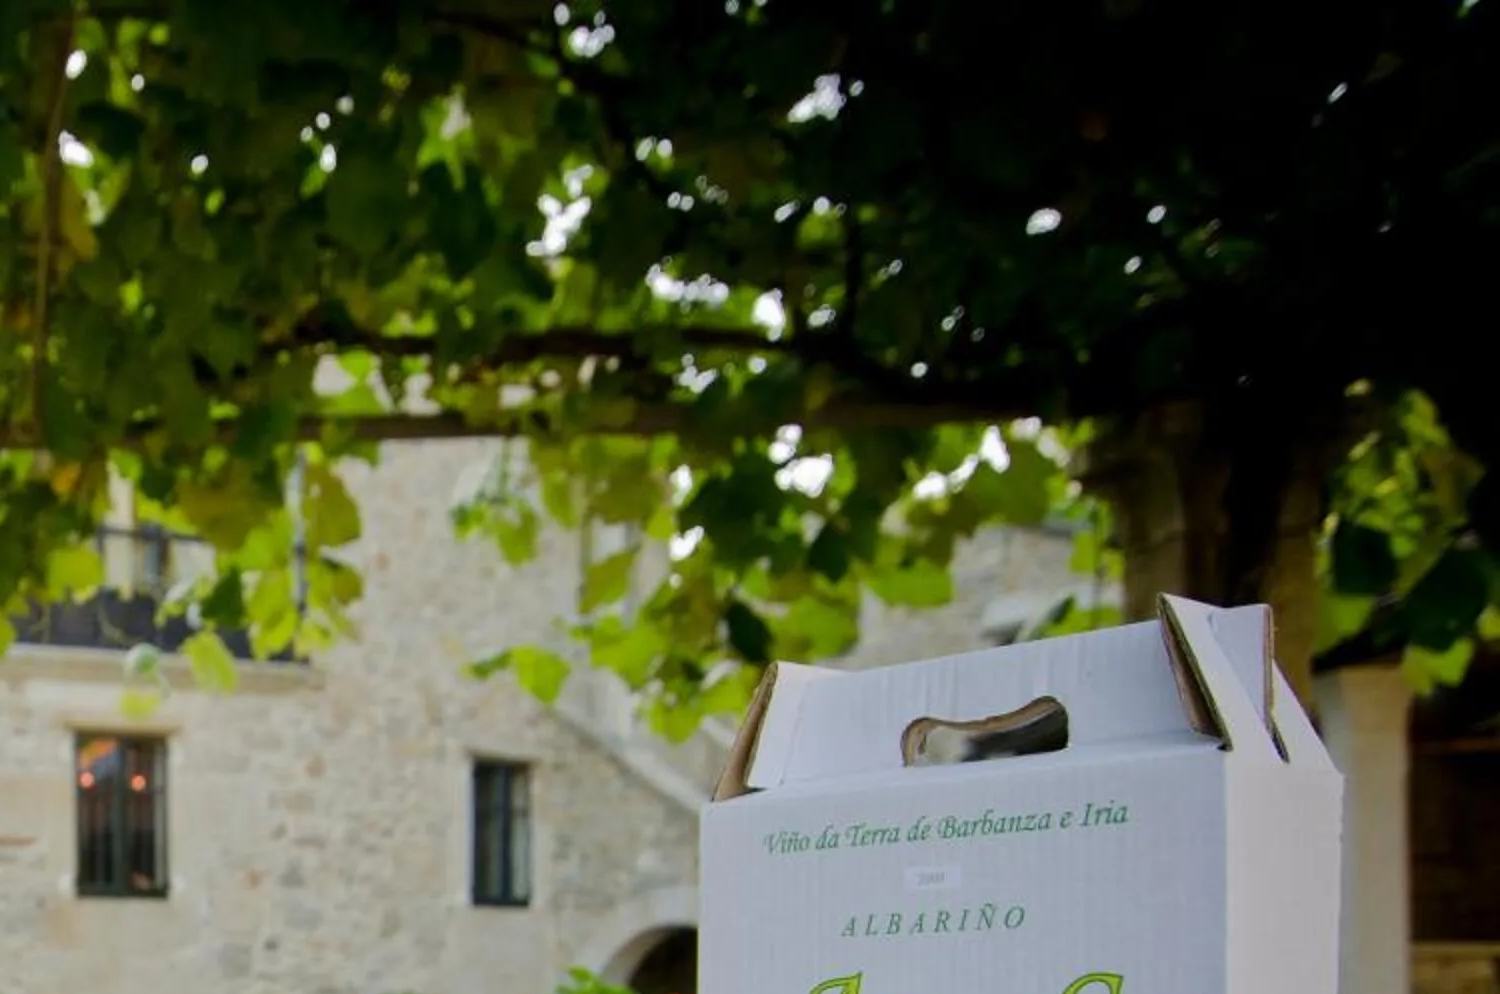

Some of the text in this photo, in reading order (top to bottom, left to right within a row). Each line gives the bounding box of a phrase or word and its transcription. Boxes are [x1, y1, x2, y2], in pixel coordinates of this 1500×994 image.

[764, 800, 1129, 854] Viño da Terra de Barbanza e Iria
[840, 903, 1026, 937] ALBARIÑO
